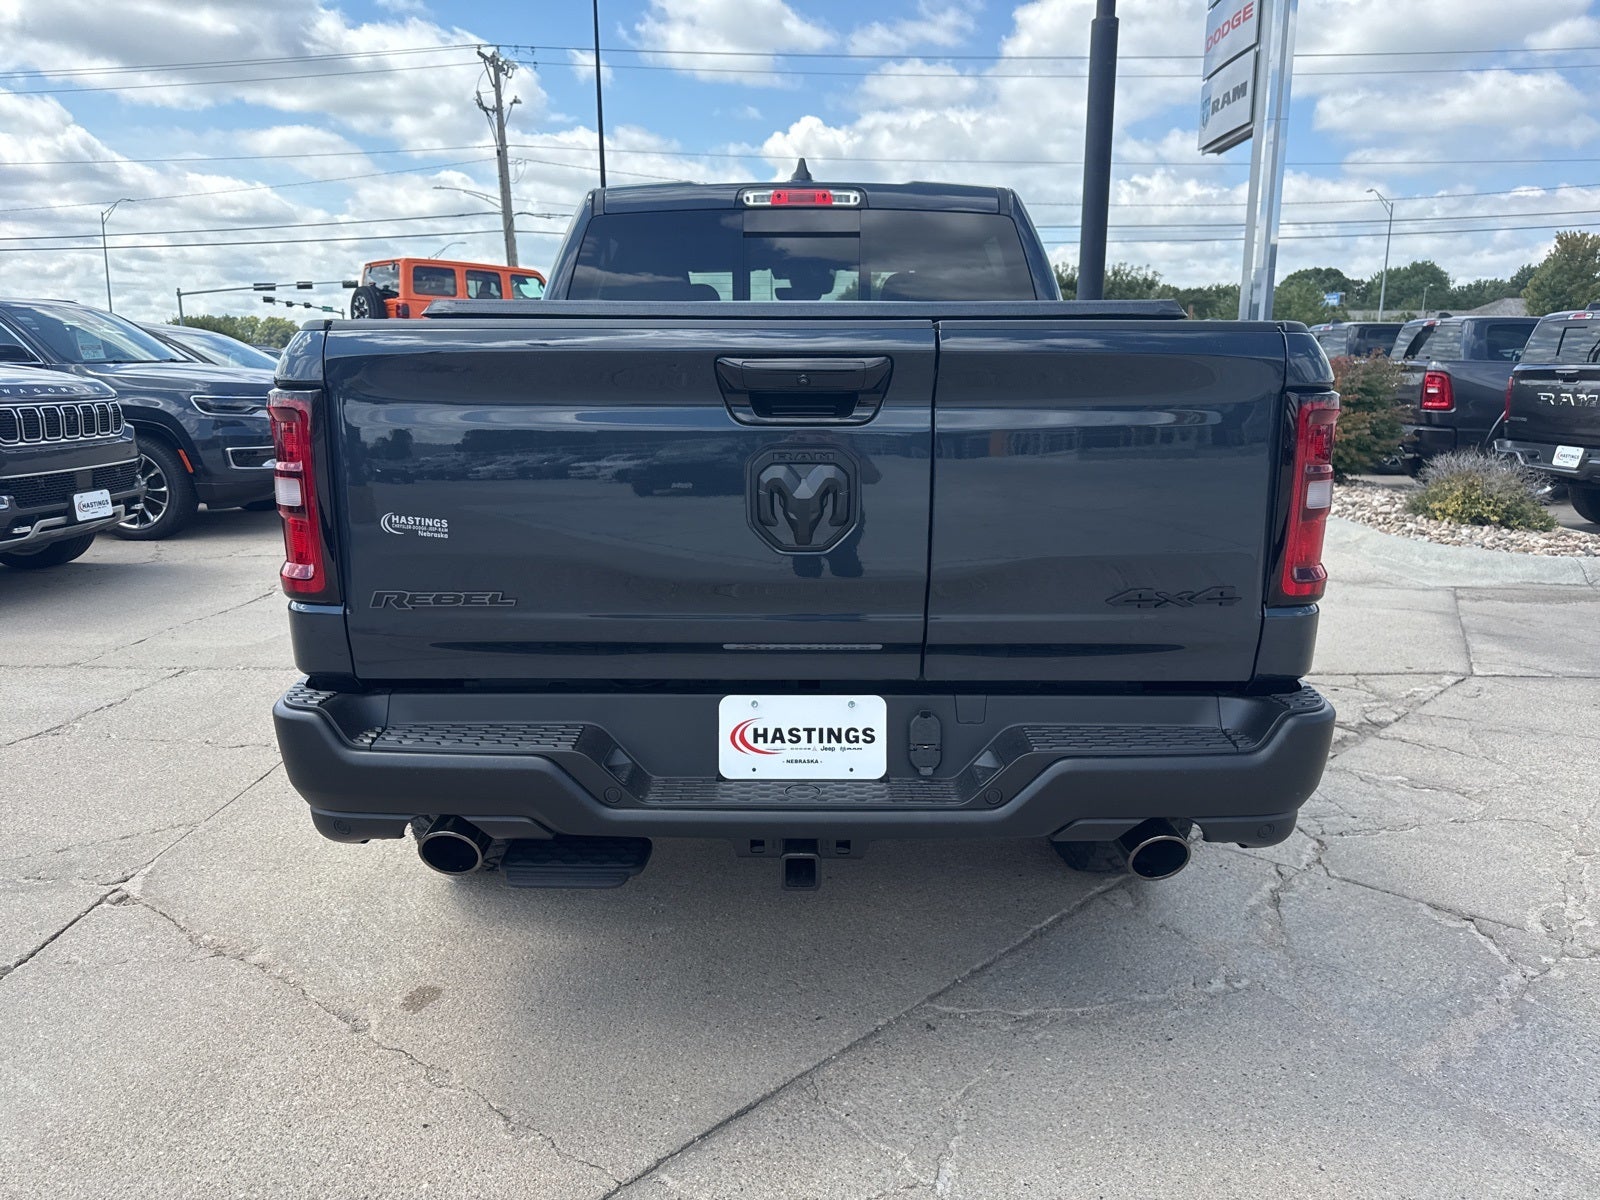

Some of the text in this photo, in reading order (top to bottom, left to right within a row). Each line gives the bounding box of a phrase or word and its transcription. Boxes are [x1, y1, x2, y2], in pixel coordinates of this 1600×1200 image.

[1205, 1, 1254, 53] DODGE
[1211, 80, 1248, 116] RAM
[1537, 392, 1599, 407] RAM
[773, 452, 835, 461] RAM
[82, 500, 109, 509] HASTINGS
[391, 514, 448, 528] HASTINGS
[418, 530, 449, 539] Nebraska
[753, 727, 876, 744] HASTINGS
